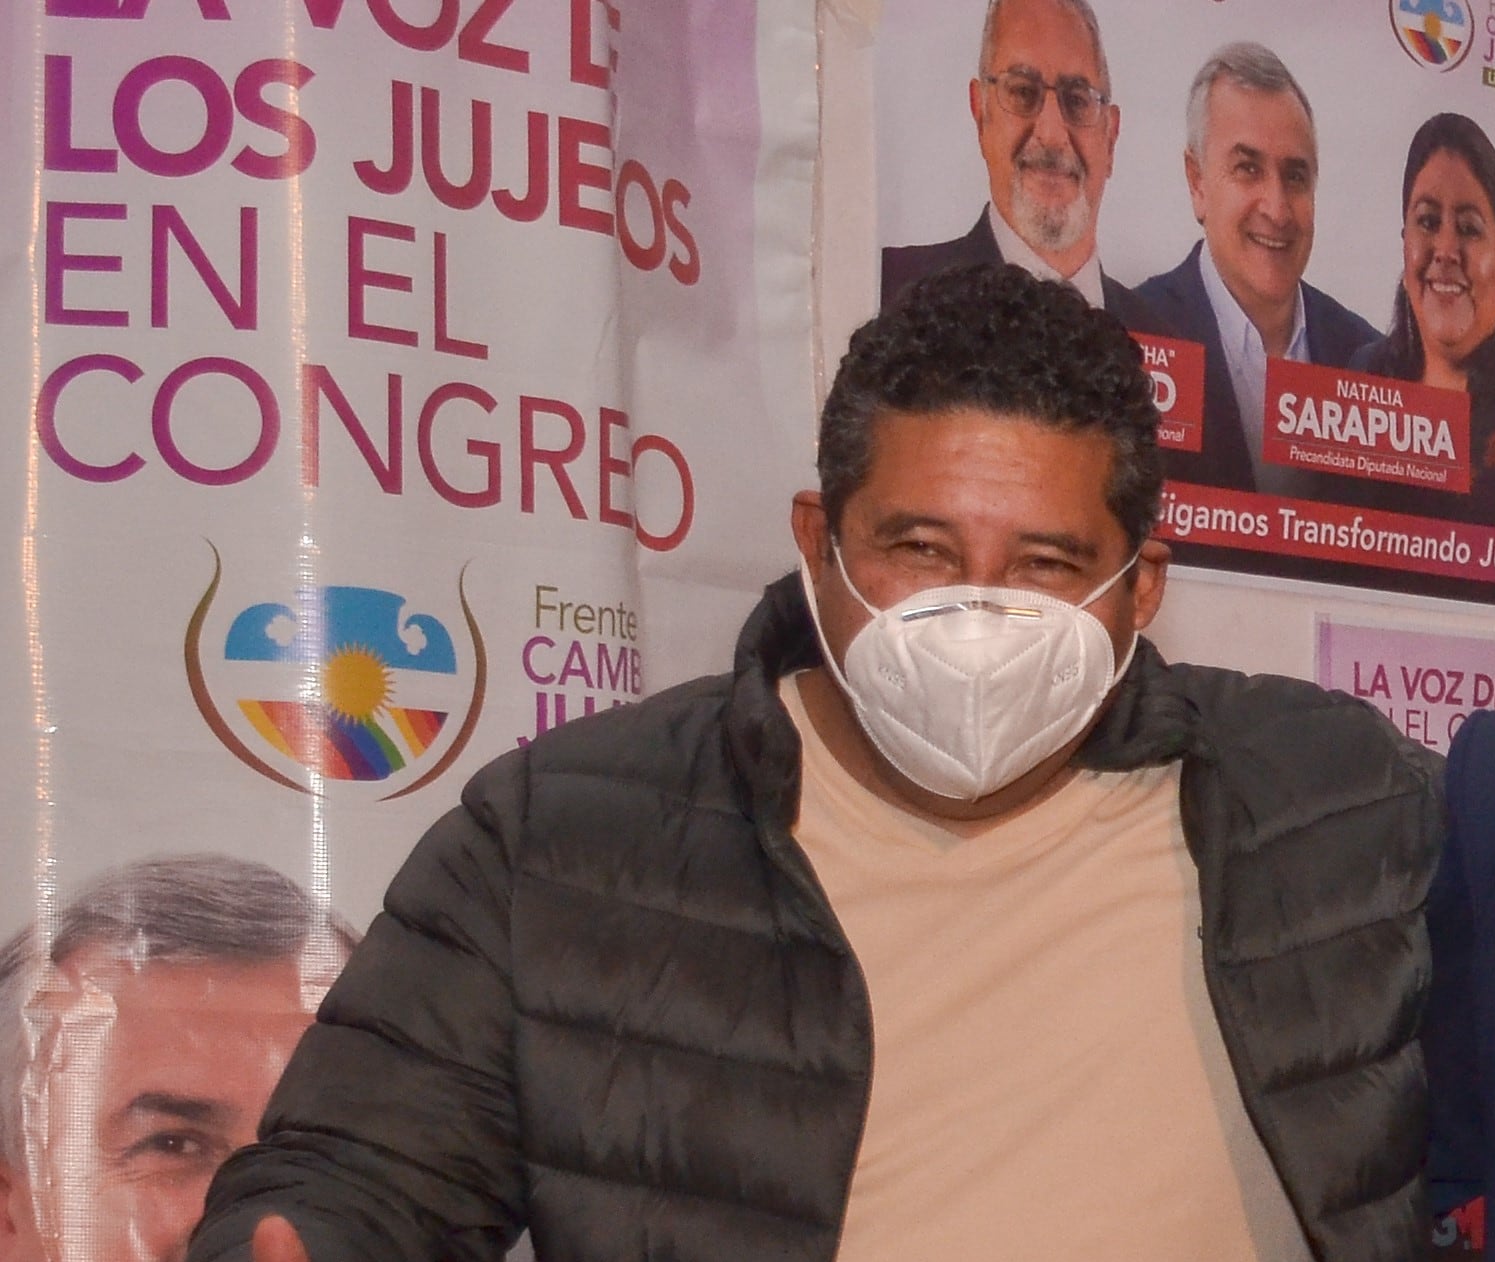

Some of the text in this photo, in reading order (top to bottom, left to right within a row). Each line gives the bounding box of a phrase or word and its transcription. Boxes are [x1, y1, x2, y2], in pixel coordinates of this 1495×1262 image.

[44, 54, 701, 286] LOS JUJEOS
[45, 200, 489, 360] EN EL
[1336, 378, 1404, 407] NATALIA
[37, 353, 696, 552] CONGREO
[1276, 392, 1457, 461] SARAPURA
[1289, 445, 1447, 483] Precandidata Diputada Nacional
[1277, 507, 1472, 564] Transformando
[535, 584, 638, 641] Frente
[521, 635, 642, 695] CAMB
[1353, 661, 1393, 700] LA
[1400, 665, 1465, 706] VOZ
[1405, 709, 1438, 746] EL
